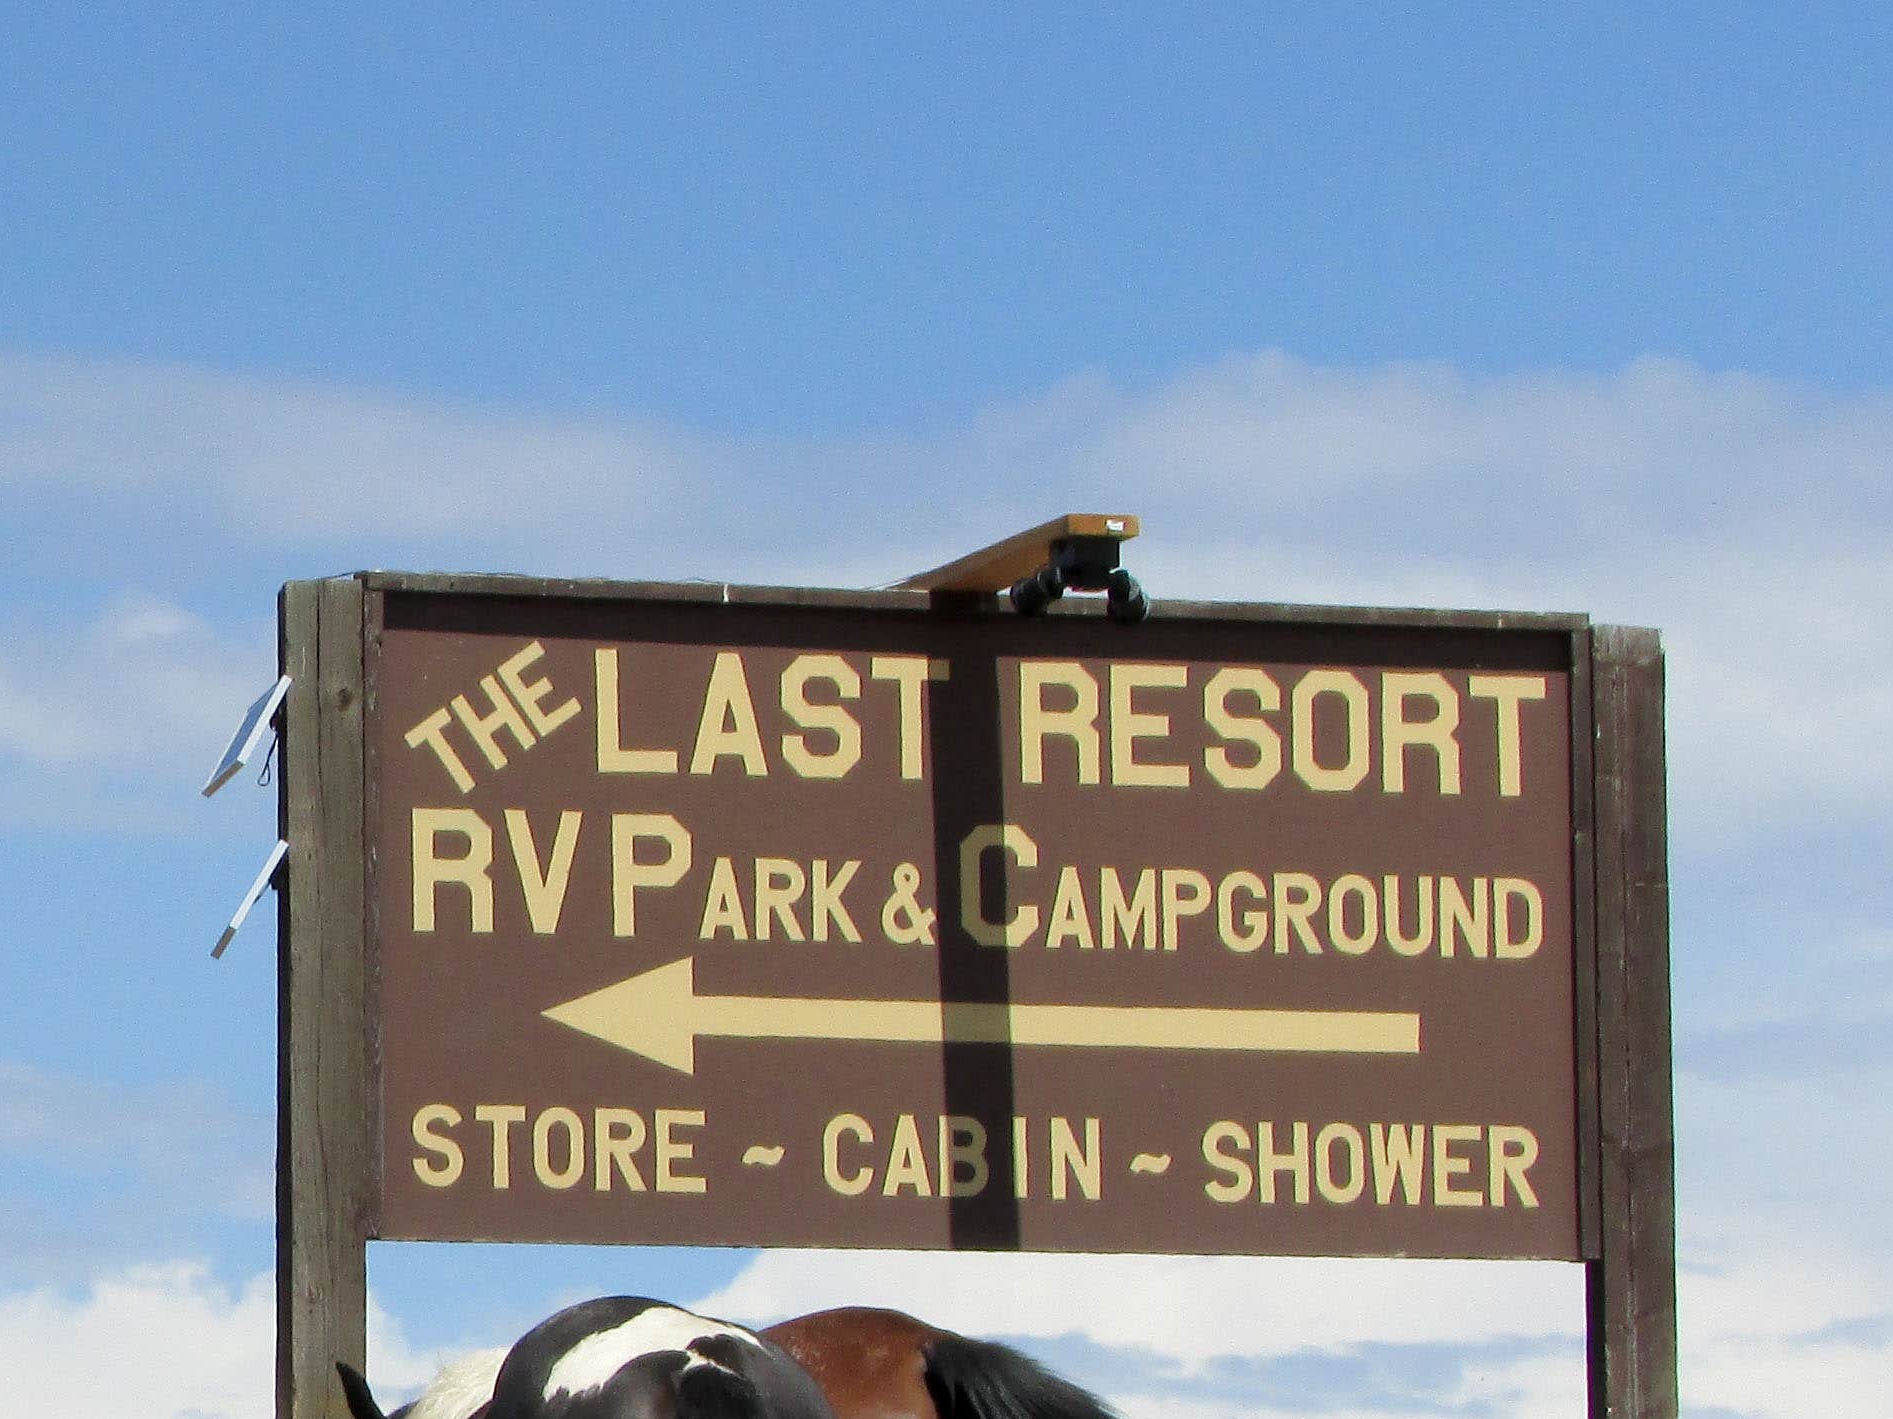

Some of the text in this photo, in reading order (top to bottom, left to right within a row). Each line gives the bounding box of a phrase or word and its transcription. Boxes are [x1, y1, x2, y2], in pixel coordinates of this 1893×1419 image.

[403, 639, 1547, 798] THE LAST RESORT
[410, 806, 584, 936] RV
[880, 861, 938, 947] &
[411, 1102, 708, 1195] STORE
[822, 1112, 1102, 1202] CABIN
[1200, 1119, 1541, 1209] SHOWER
